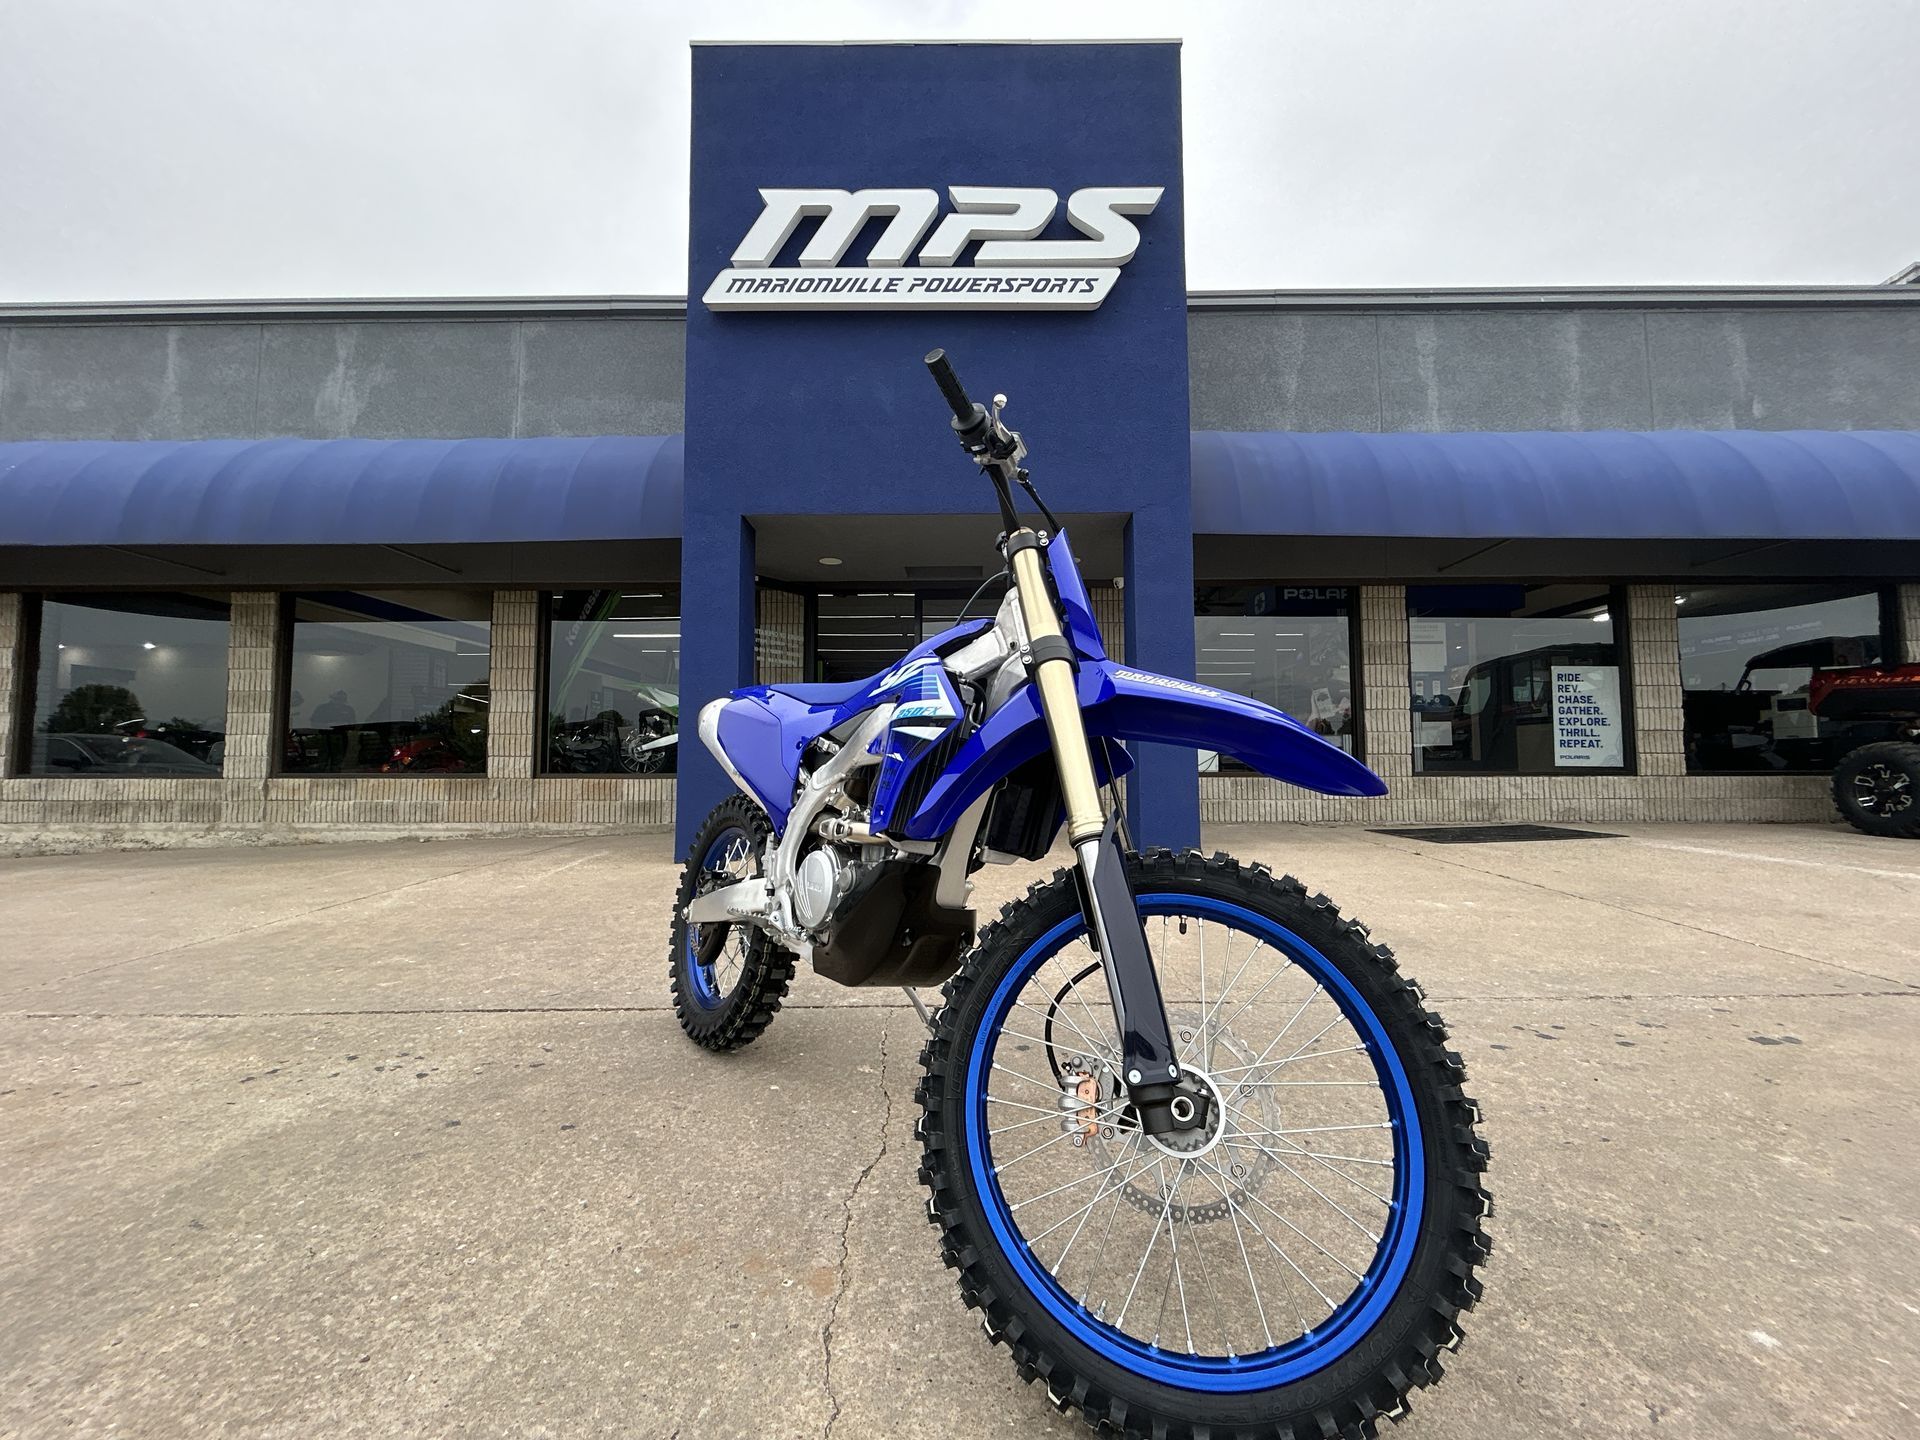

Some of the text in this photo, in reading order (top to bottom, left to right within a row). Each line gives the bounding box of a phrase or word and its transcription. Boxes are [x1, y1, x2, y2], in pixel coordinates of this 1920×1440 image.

[731, 186, 1165, 268] MPS
[725, 277, 1099, 294] MARIONVILLE POWERSPORTS
[1557, 673, 1584, 682] RIDE.
[1558, 684, 1581, 693] REV.
[1558, 695, 1597, 704] CHASE.
[1558, 706, 1604, 715] GATHER.
[1559, 717, 1611, 726] EXPLORE.
[1560, 728, 1600, 737] THRILL.
[1560, 739, 1604, 749] REPEAT.
